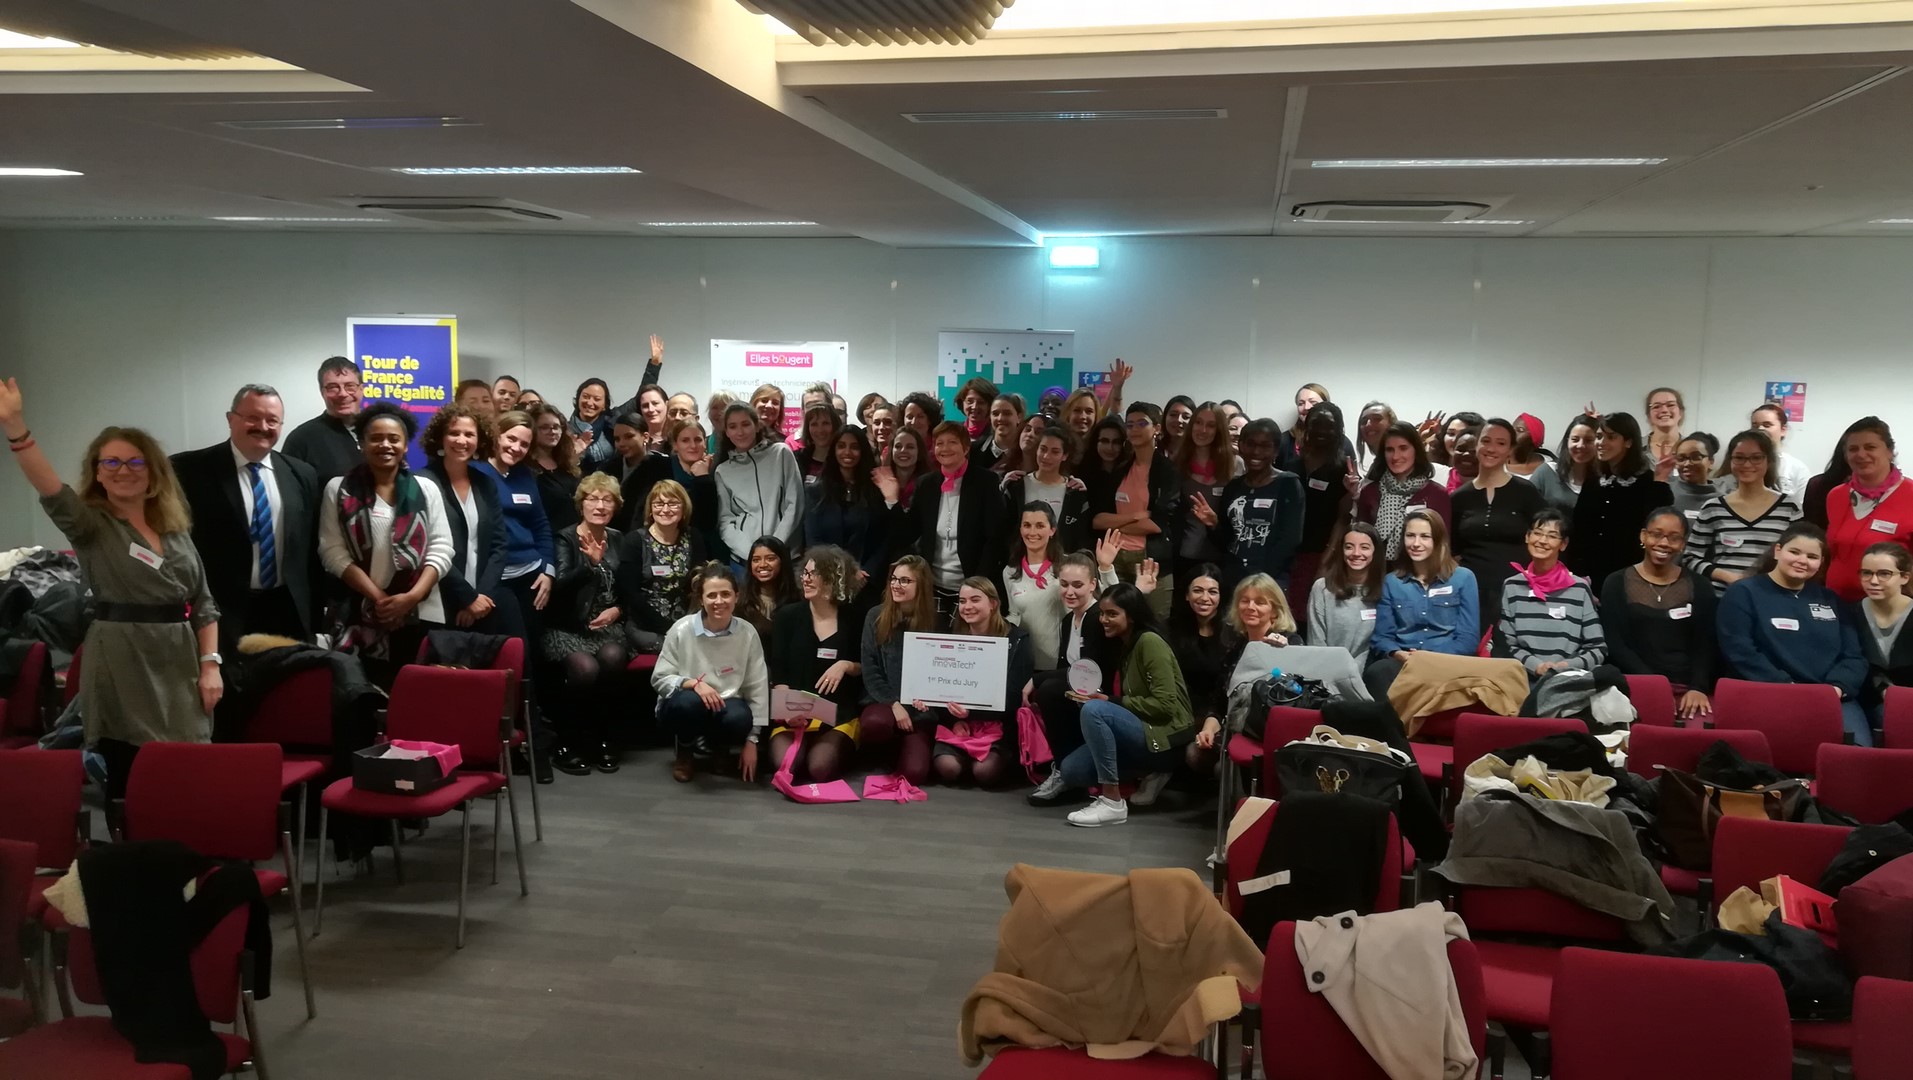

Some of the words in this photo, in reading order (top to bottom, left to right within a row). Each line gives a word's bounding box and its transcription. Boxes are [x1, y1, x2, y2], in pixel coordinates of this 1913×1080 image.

[361, 355, 398, 369] Tour
[399, 356, 420, 370] de
[750, 354, 771, 364] Elles
[362, 370, 414, 384] France
[363, 384, 382, 398] de
[938, 676, 951, 684] Prix
[953, 678, 962, 686] du
[963, 679, 978, 688] Jury
